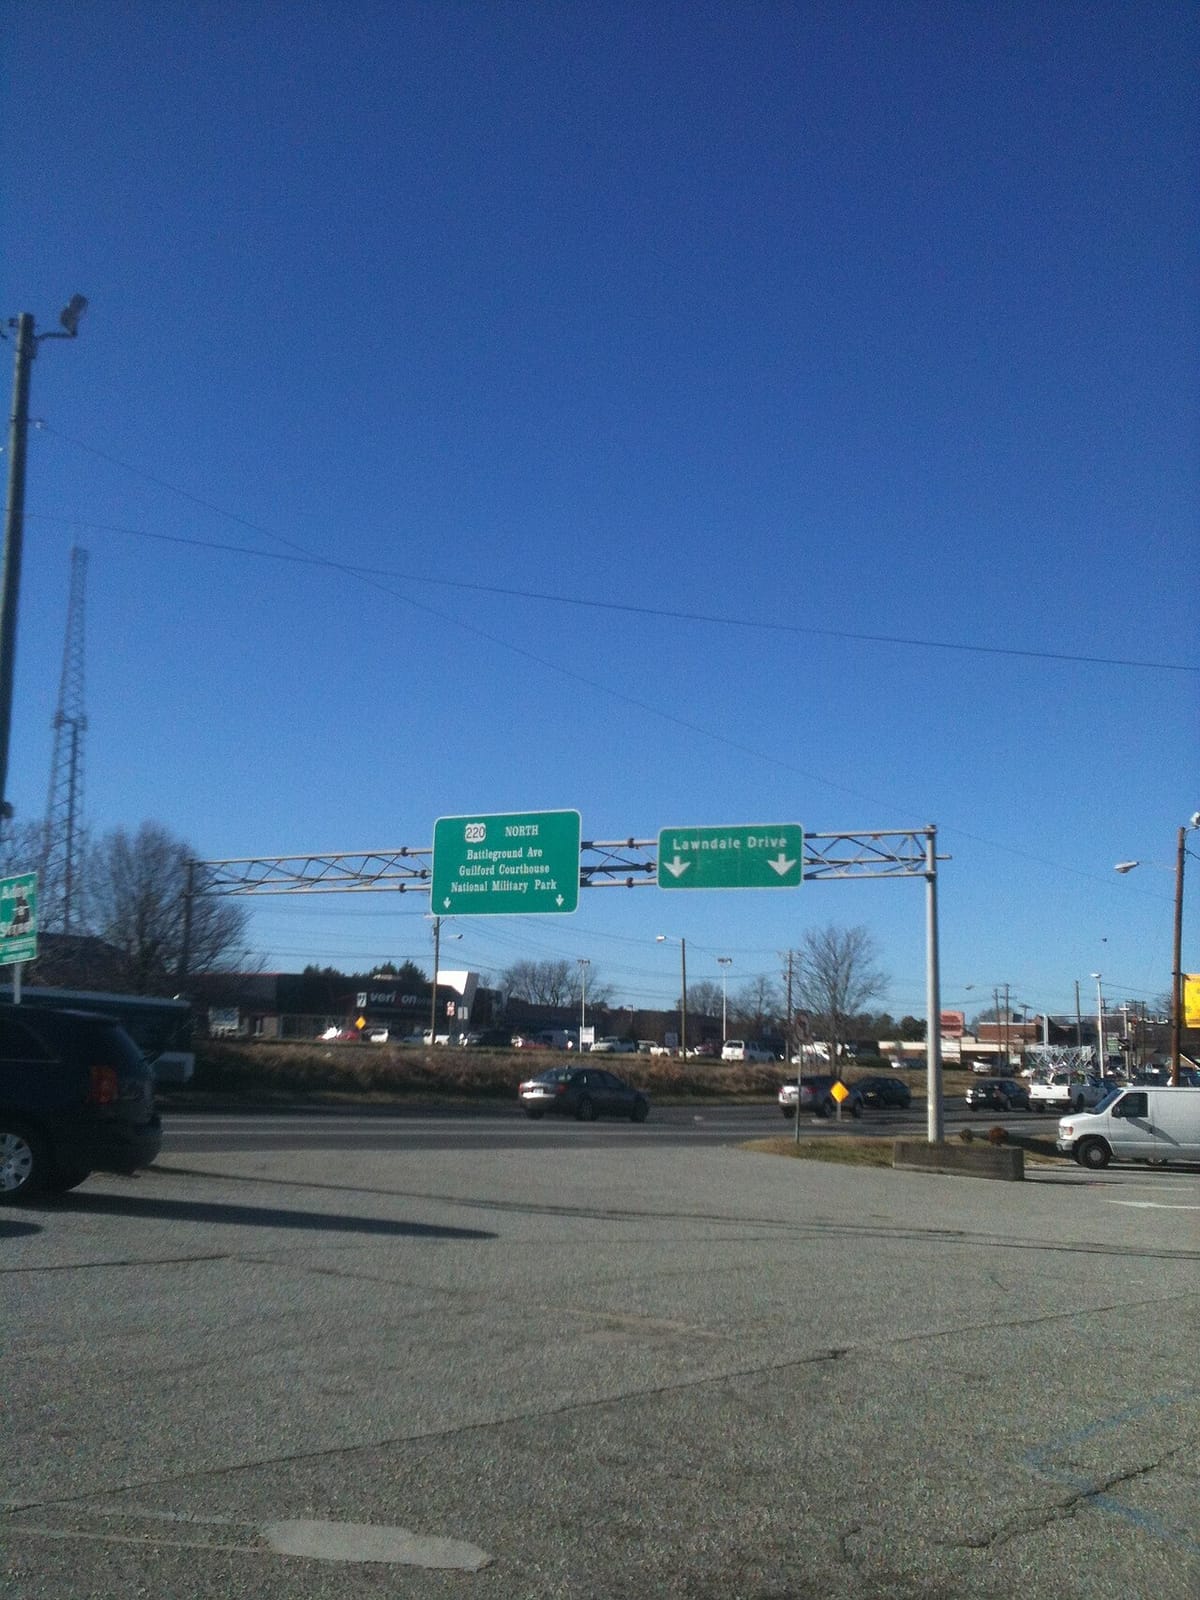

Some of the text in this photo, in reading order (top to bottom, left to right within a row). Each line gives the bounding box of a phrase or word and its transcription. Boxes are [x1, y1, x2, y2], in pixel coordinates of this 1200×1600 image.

[466, 825, 539, 839] 220 NORTH
[673, 836, 787, 850] Lawndale Drive
[467, 847, 542, 861] Battleground Ave
[459, 863, 550, 876] Guilford Courthouse
[451, 879, 557, 893] National Military Park
[370, 990, 417, 1005] verion
